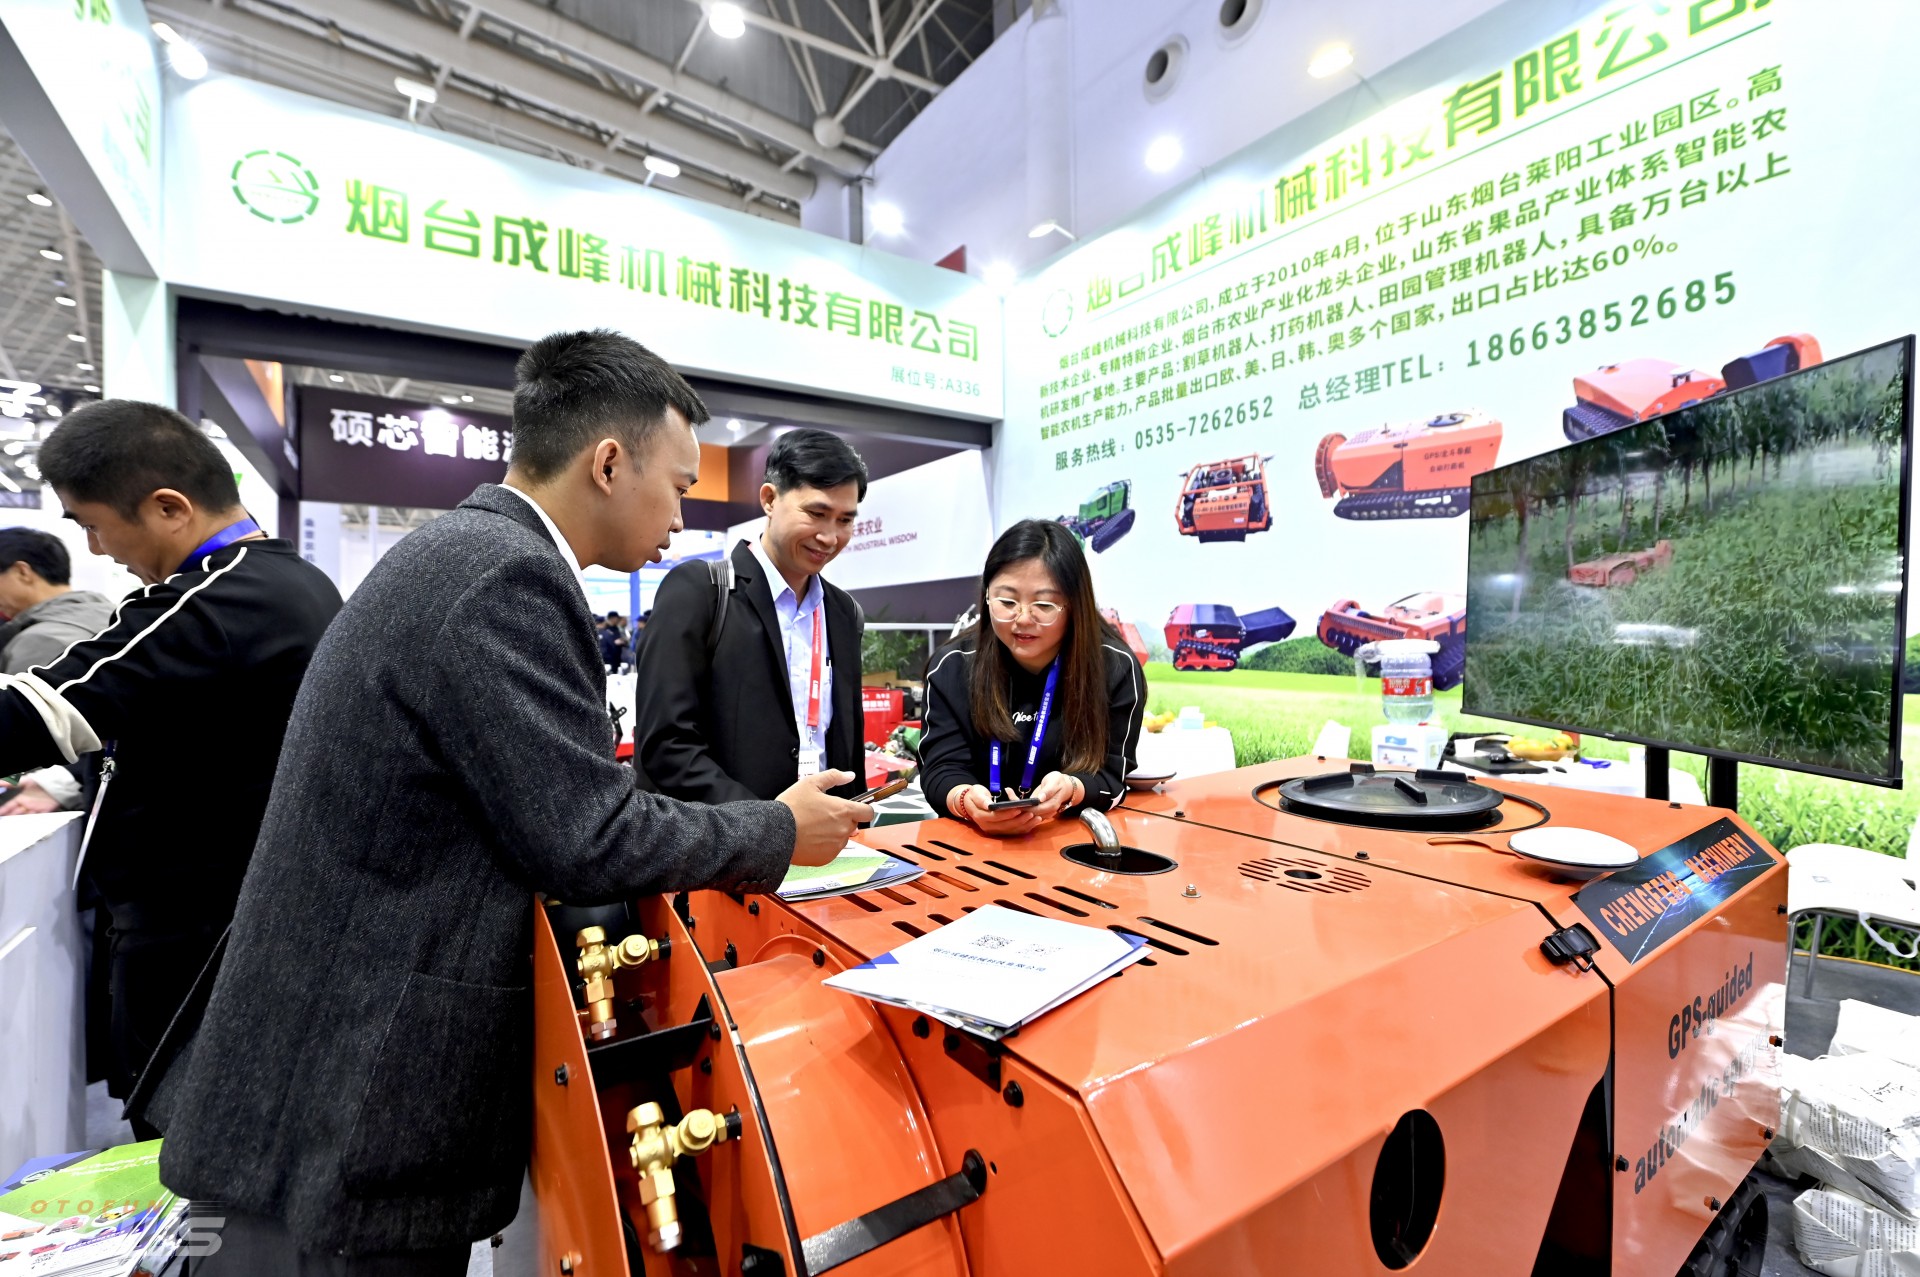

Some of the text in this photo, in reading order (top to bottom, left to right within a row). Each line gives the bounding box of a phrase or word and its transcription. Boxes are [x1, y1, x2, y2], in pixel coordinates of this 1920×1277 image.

[345, 177, 980, 363] 烟台成峰机械科技有限公司
[1134, 395, 1274, 451] 0535-7262652
[1466, 271, 1737, 368] 18663852685
[853, 538, 887, 552] INDUSTRIAL
[888, 532, 918, 545] WISDOM
[1599, 832, 1756, 937] CHENGFENG MACHINERY
[1668, 951, 1754, 1060] GPS-guided
